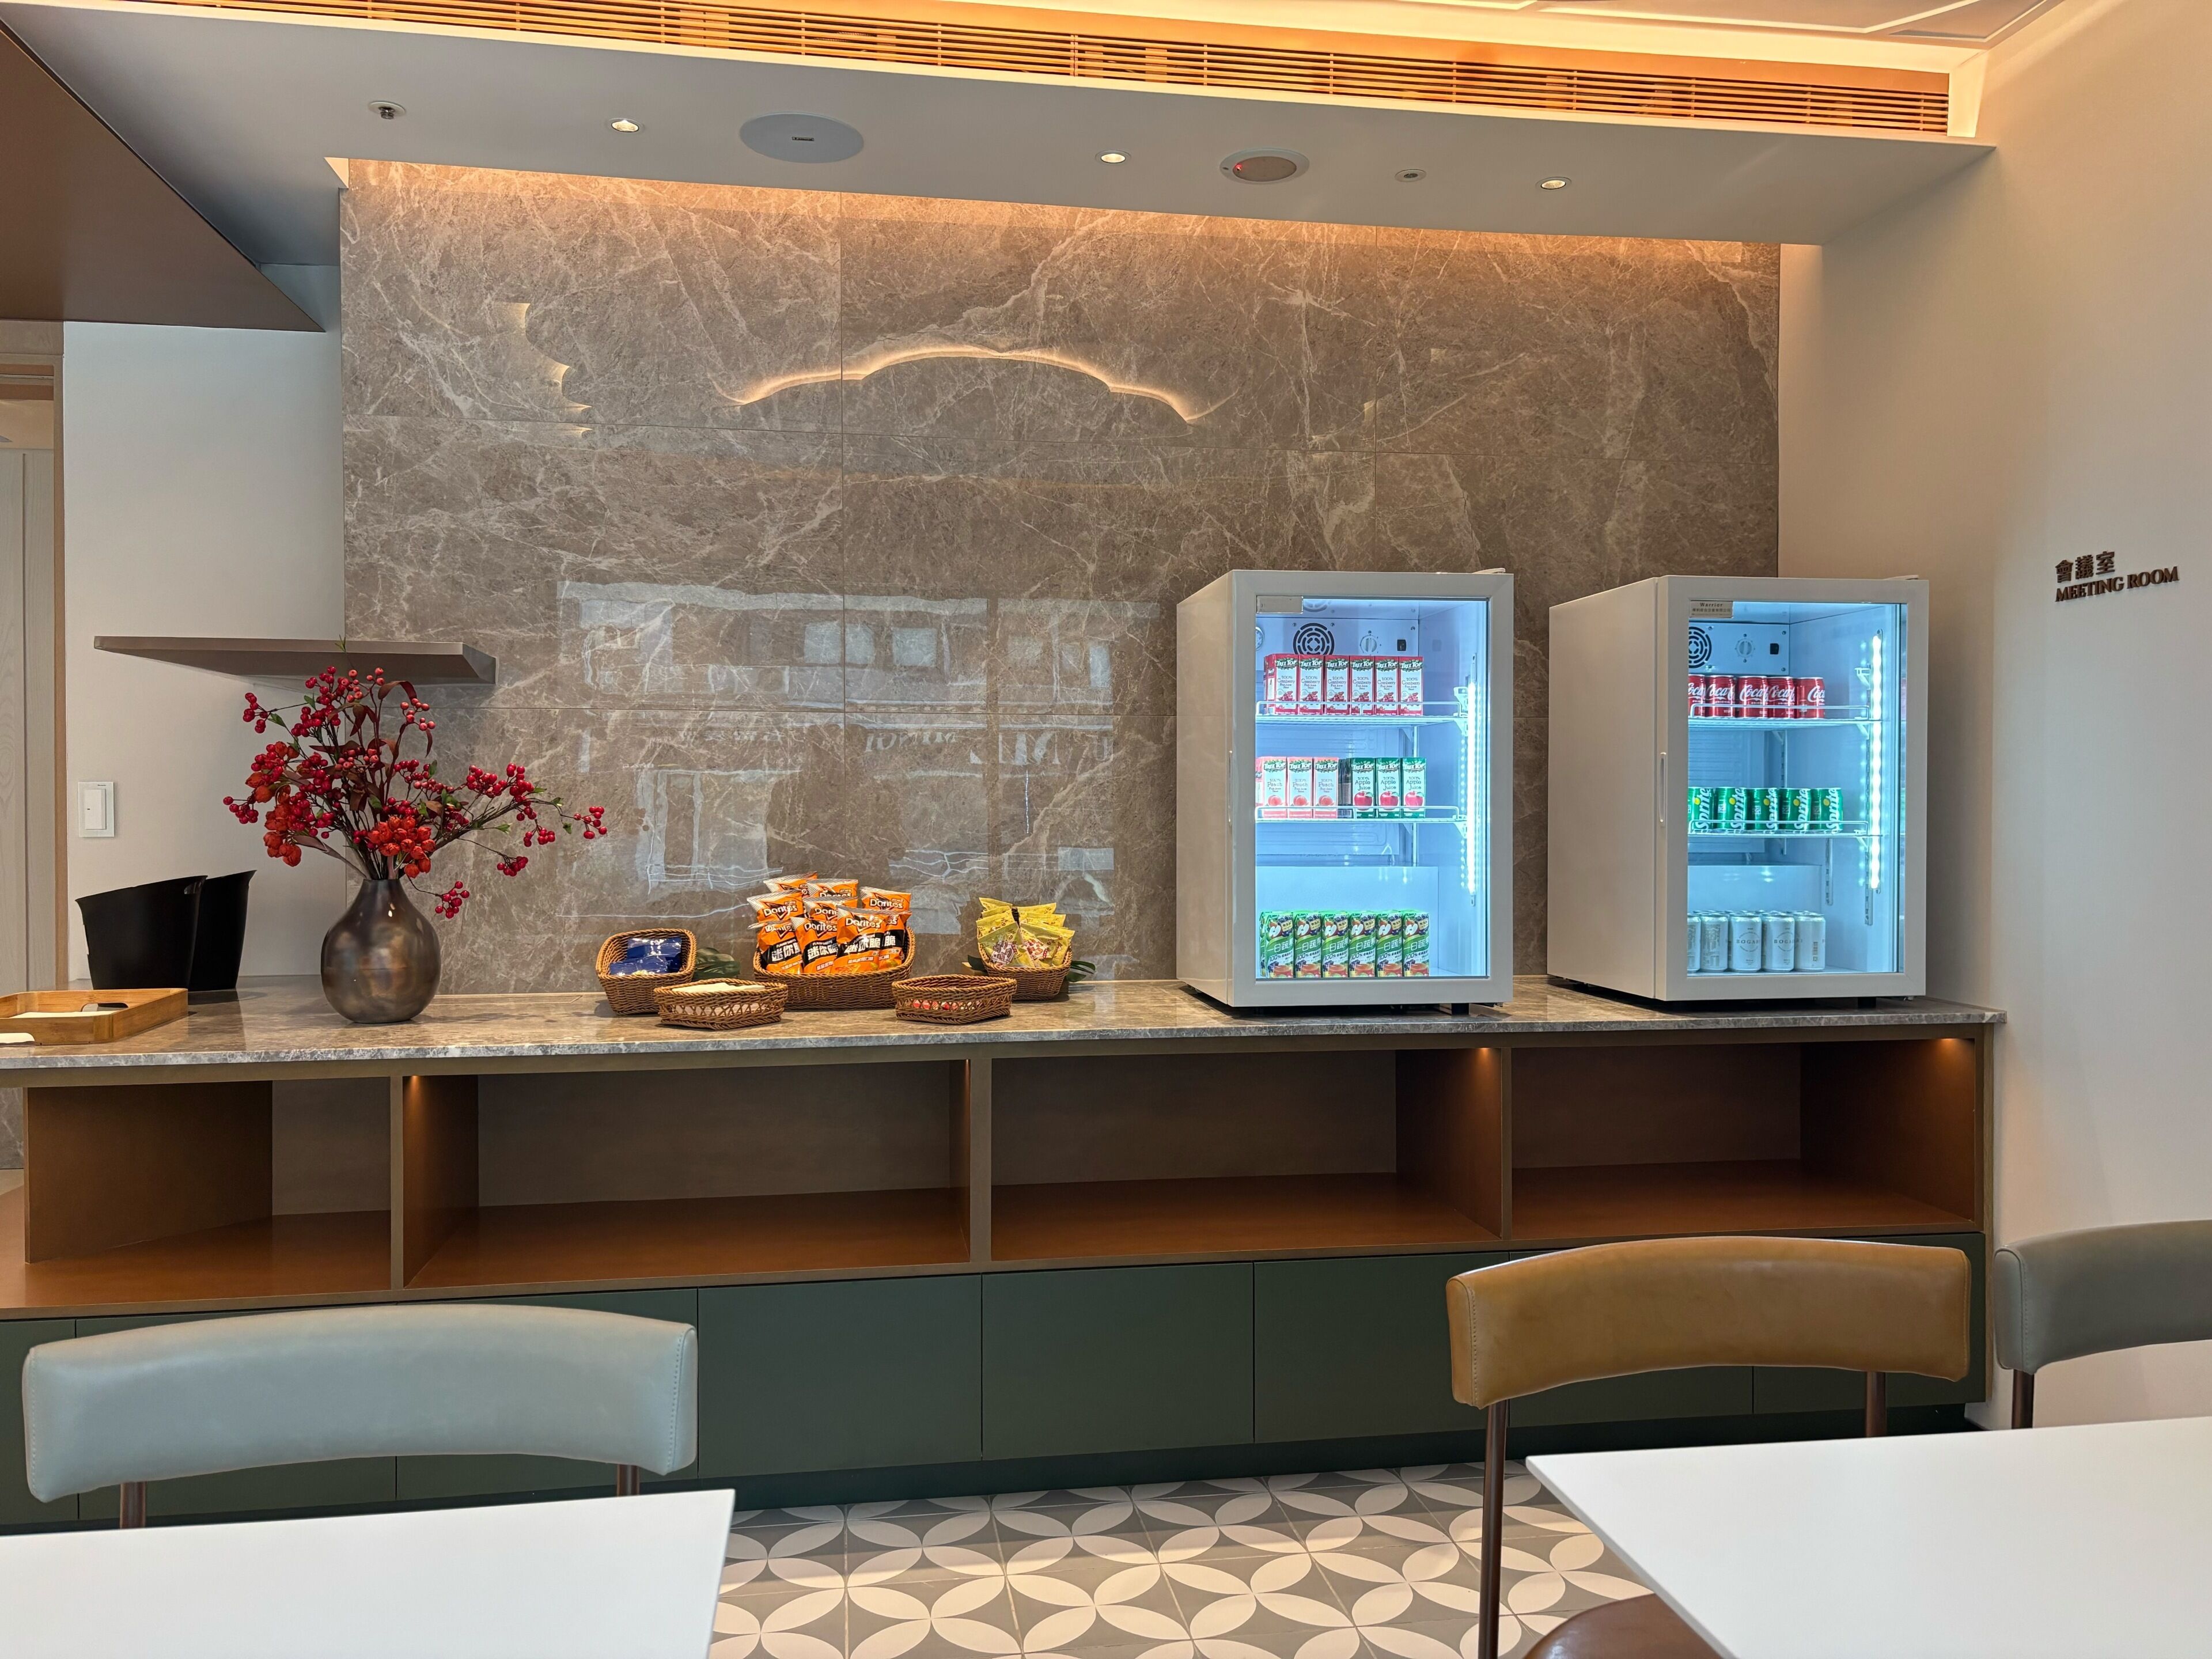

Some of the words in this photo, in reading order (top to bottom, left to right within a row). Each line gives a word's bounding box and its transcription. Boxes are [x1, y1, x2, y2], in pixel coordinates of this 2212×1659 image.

[2055, 551, 2115, 583] 會議室
[2055, 577, 2124, 602] MEETING
[2127, 566, 2179, 589] ROOM
[1695, 789, 1710, 829] Sprite
[1730, 789, 1743, 828] Sprite
[1766, 789, 1776, 829] Sprite
[1794, 789, 1807, 829] Sprite
[1825, 789, 1838, 829] Sprite
[763, 905, 798, 917] Doritos
[870, 899, 903, 908] Doritos
[804, 923, 837, 931] Doritos
[846, 918, 880, 928] Doritos
